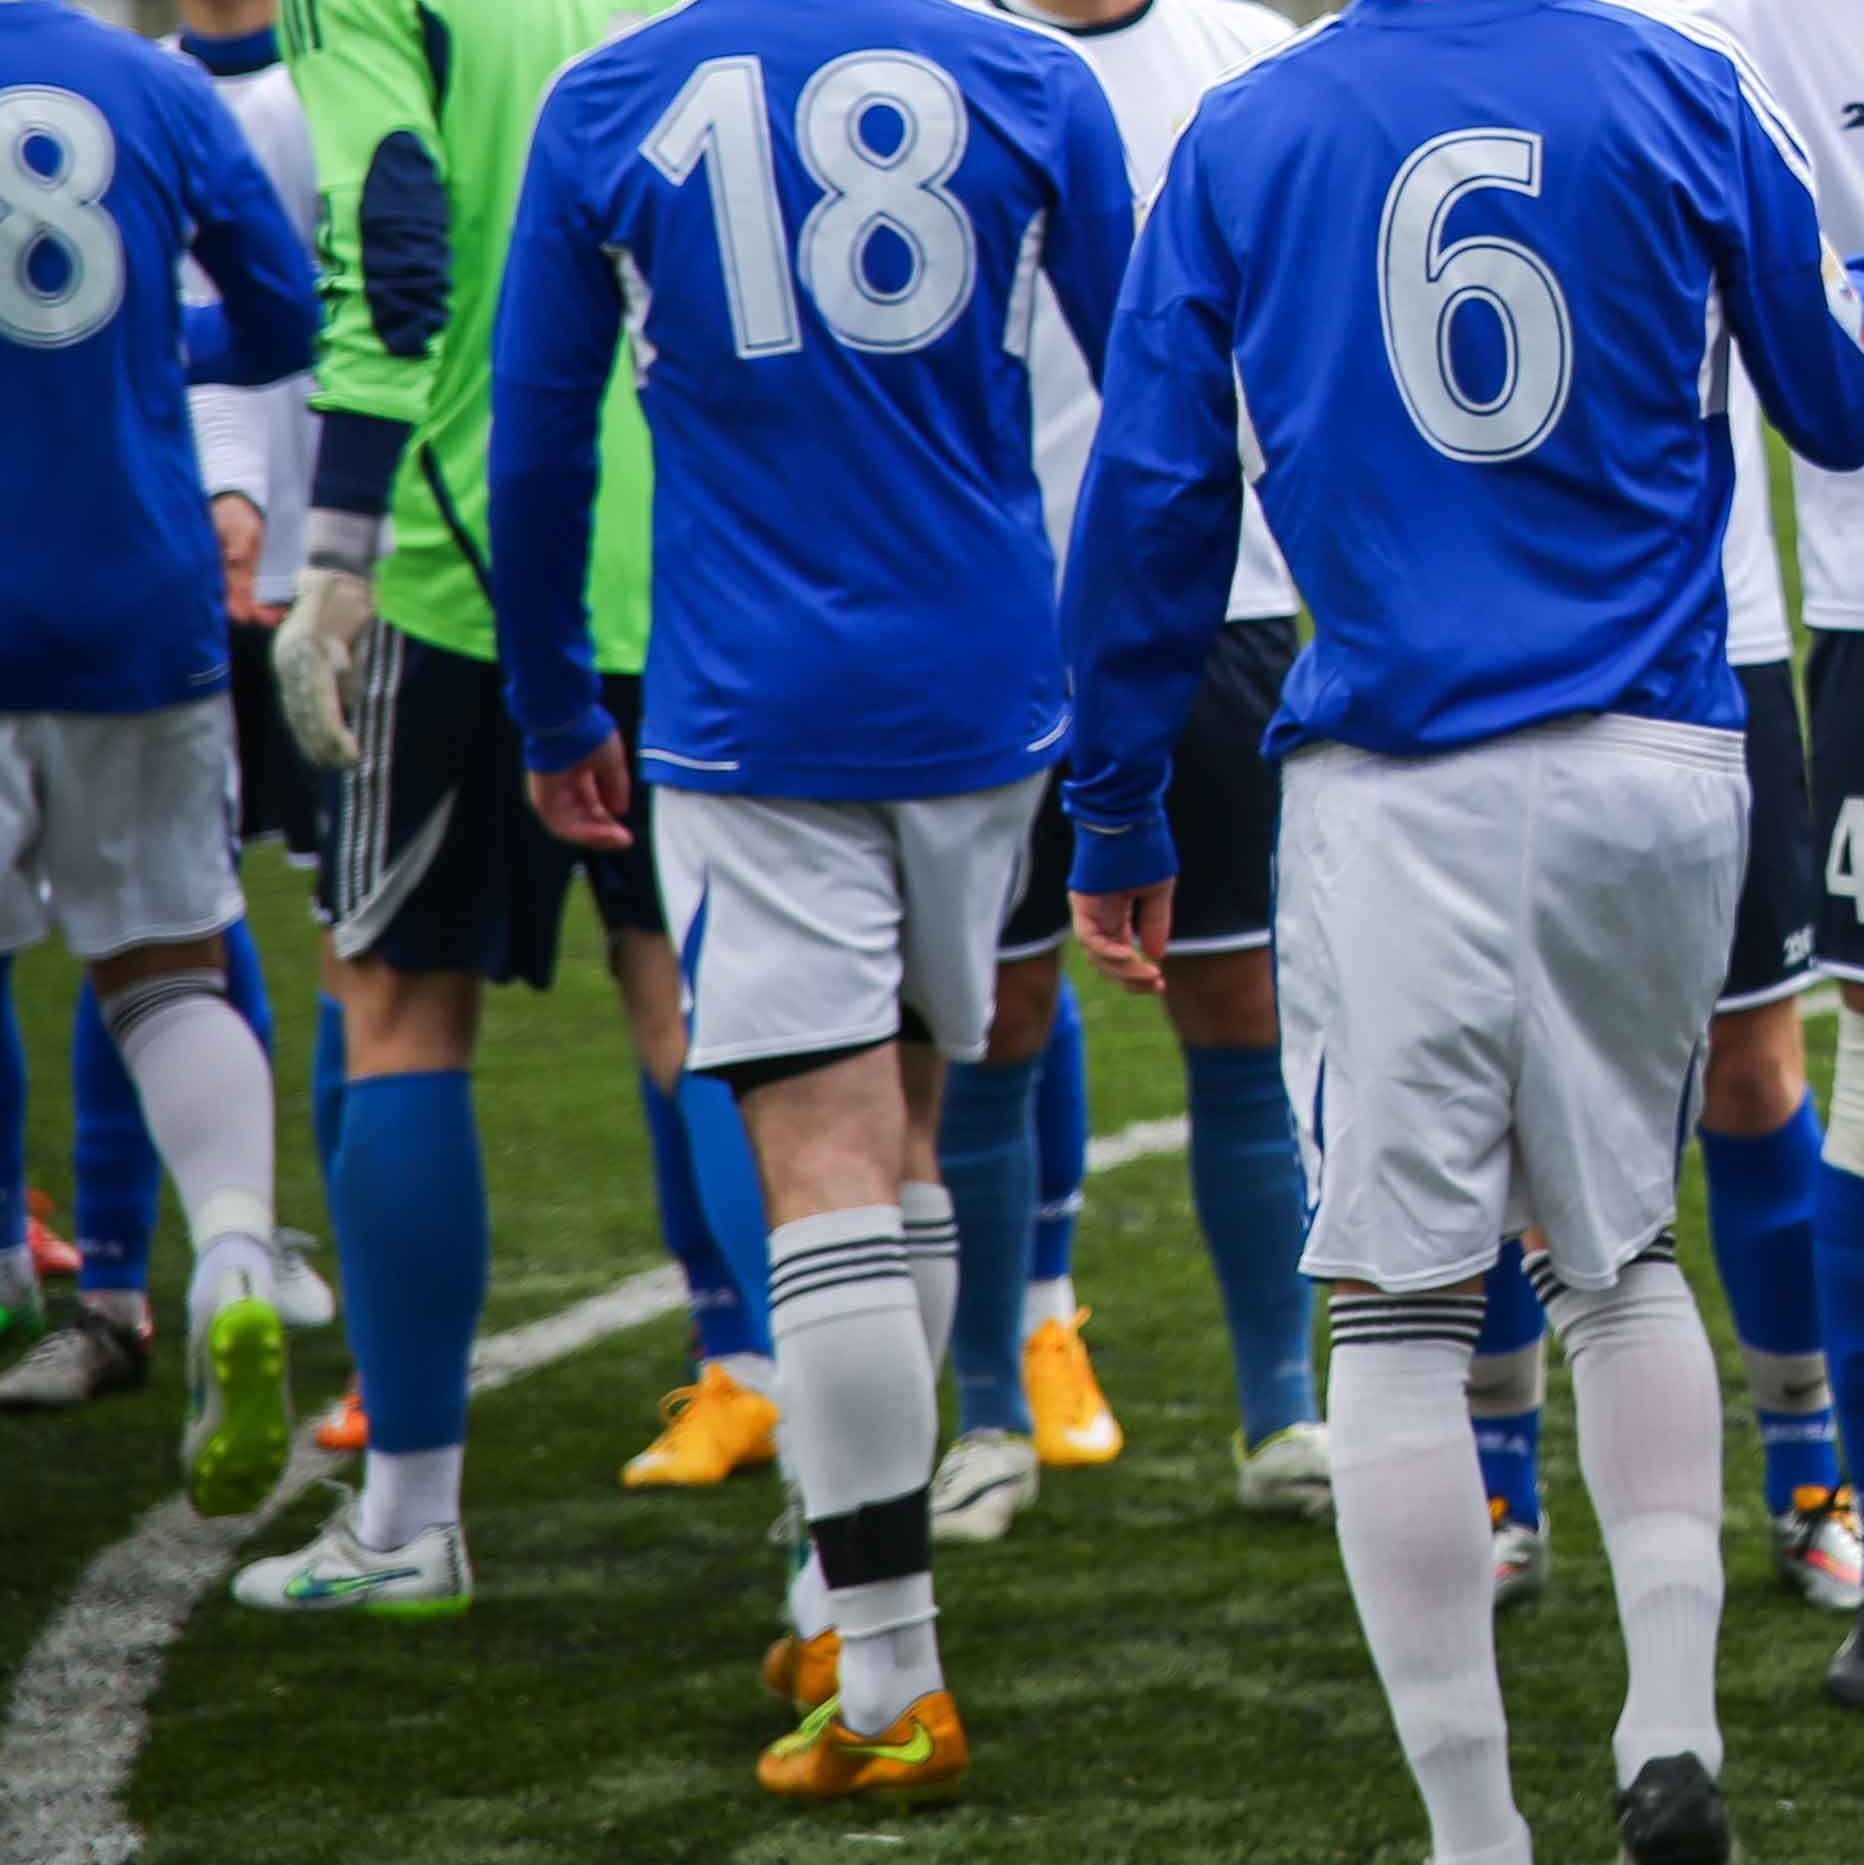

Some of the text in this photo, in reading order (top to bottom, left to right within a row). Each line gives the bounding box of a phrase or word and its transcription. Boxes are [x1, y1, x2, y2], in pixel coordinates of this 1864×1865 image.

[0, 85, 126, 348] 8
[640, 48, 976, 360] 18
[1377, 127, 1573, 463] 6
